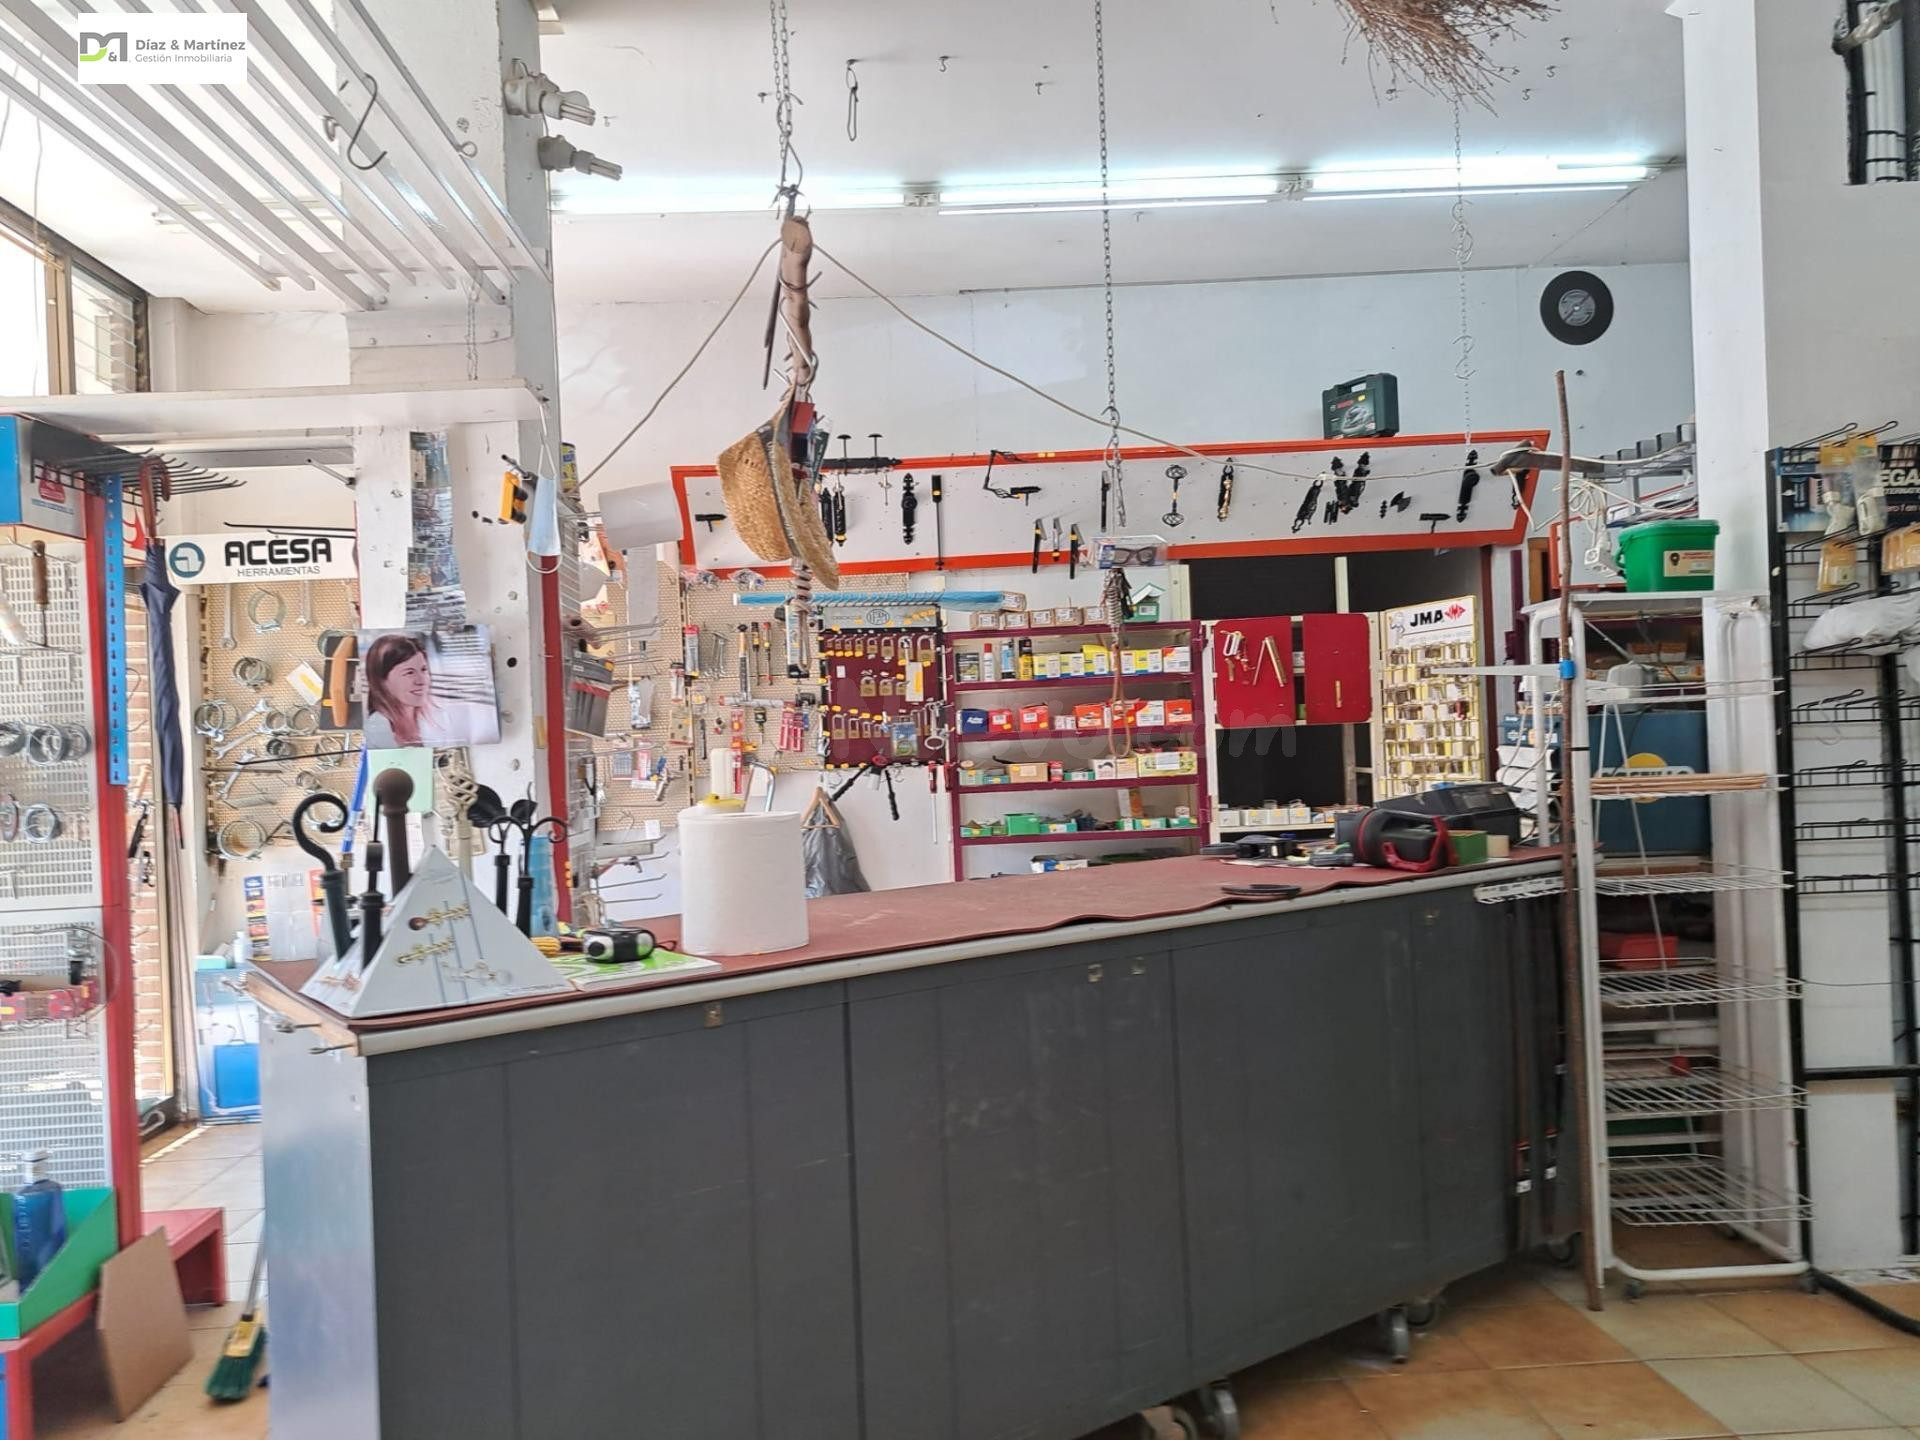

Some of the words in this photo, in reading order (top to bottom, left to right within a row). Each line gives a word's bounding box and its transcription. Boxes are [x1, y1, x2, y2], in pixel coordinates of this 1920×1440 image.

[224, 538, 332, 567] ACESA
[237, 566, 321, 577] HERRAMIENTAS
[1409, 609, 1444, 627] JMA
